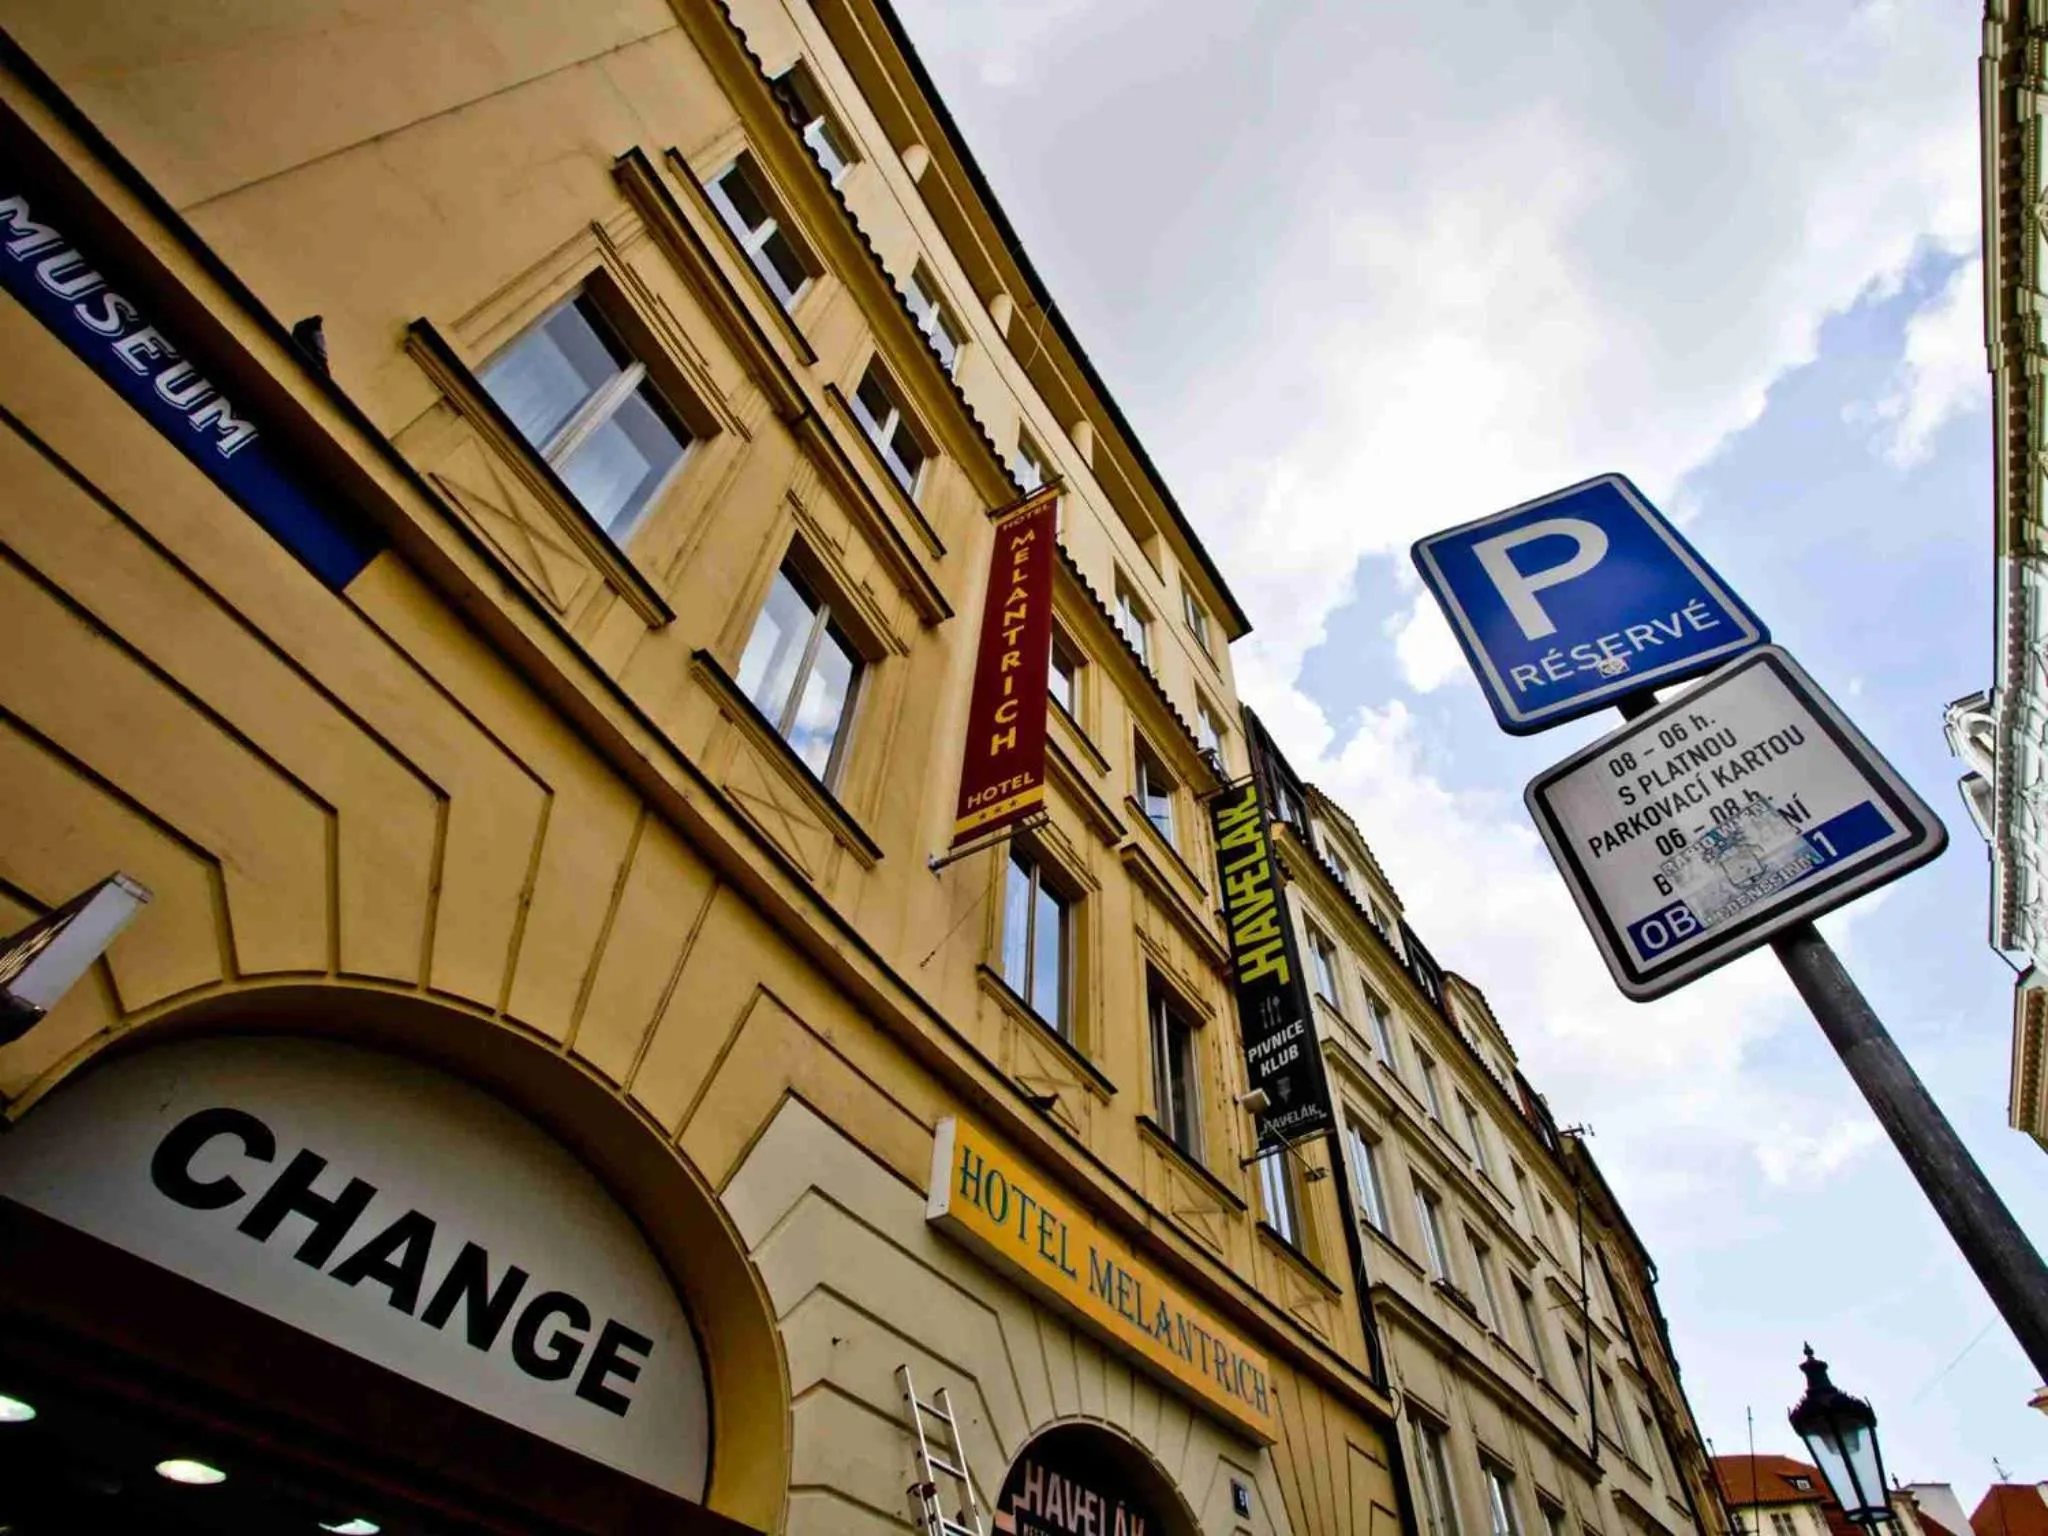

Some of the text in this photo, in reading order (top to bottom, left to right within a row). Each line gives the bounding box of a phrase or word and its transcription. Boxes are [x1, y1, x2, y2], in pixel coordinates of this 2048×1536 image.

[0, 196, 260, 458] MUSEUM
[1003, 503, 1051, 531] HOTEL
[1472, 518, 1609, 641] P
[990, 529, 1036, 756] MELANTRICH
[1509, 598, 1721, 693] RÉSERVÉ
[968, 772, 1035, 809] HOTEL
[1588, 723, 1807, 859] PARKOVACÍ KARTOU
[1608, 750, 1638, 778] 08
[1658, 722, 1688, 751] 06
[1693, 713, 1717, 733] h.
[1618, 728, 1738, 806] S PLATNOU
[1216, 785, 1290, 985] HAVELÁK
[1655, 827, 1687, 858] 06
[1248, 1018, 1304, 1064] PIVNICE
[1260, 1043, 1300, 1077] KLUB
[150, 1107, 654, 1417] CHANGE
[959, 1144, 1270, 1417] HOTEL MELANTRICH
